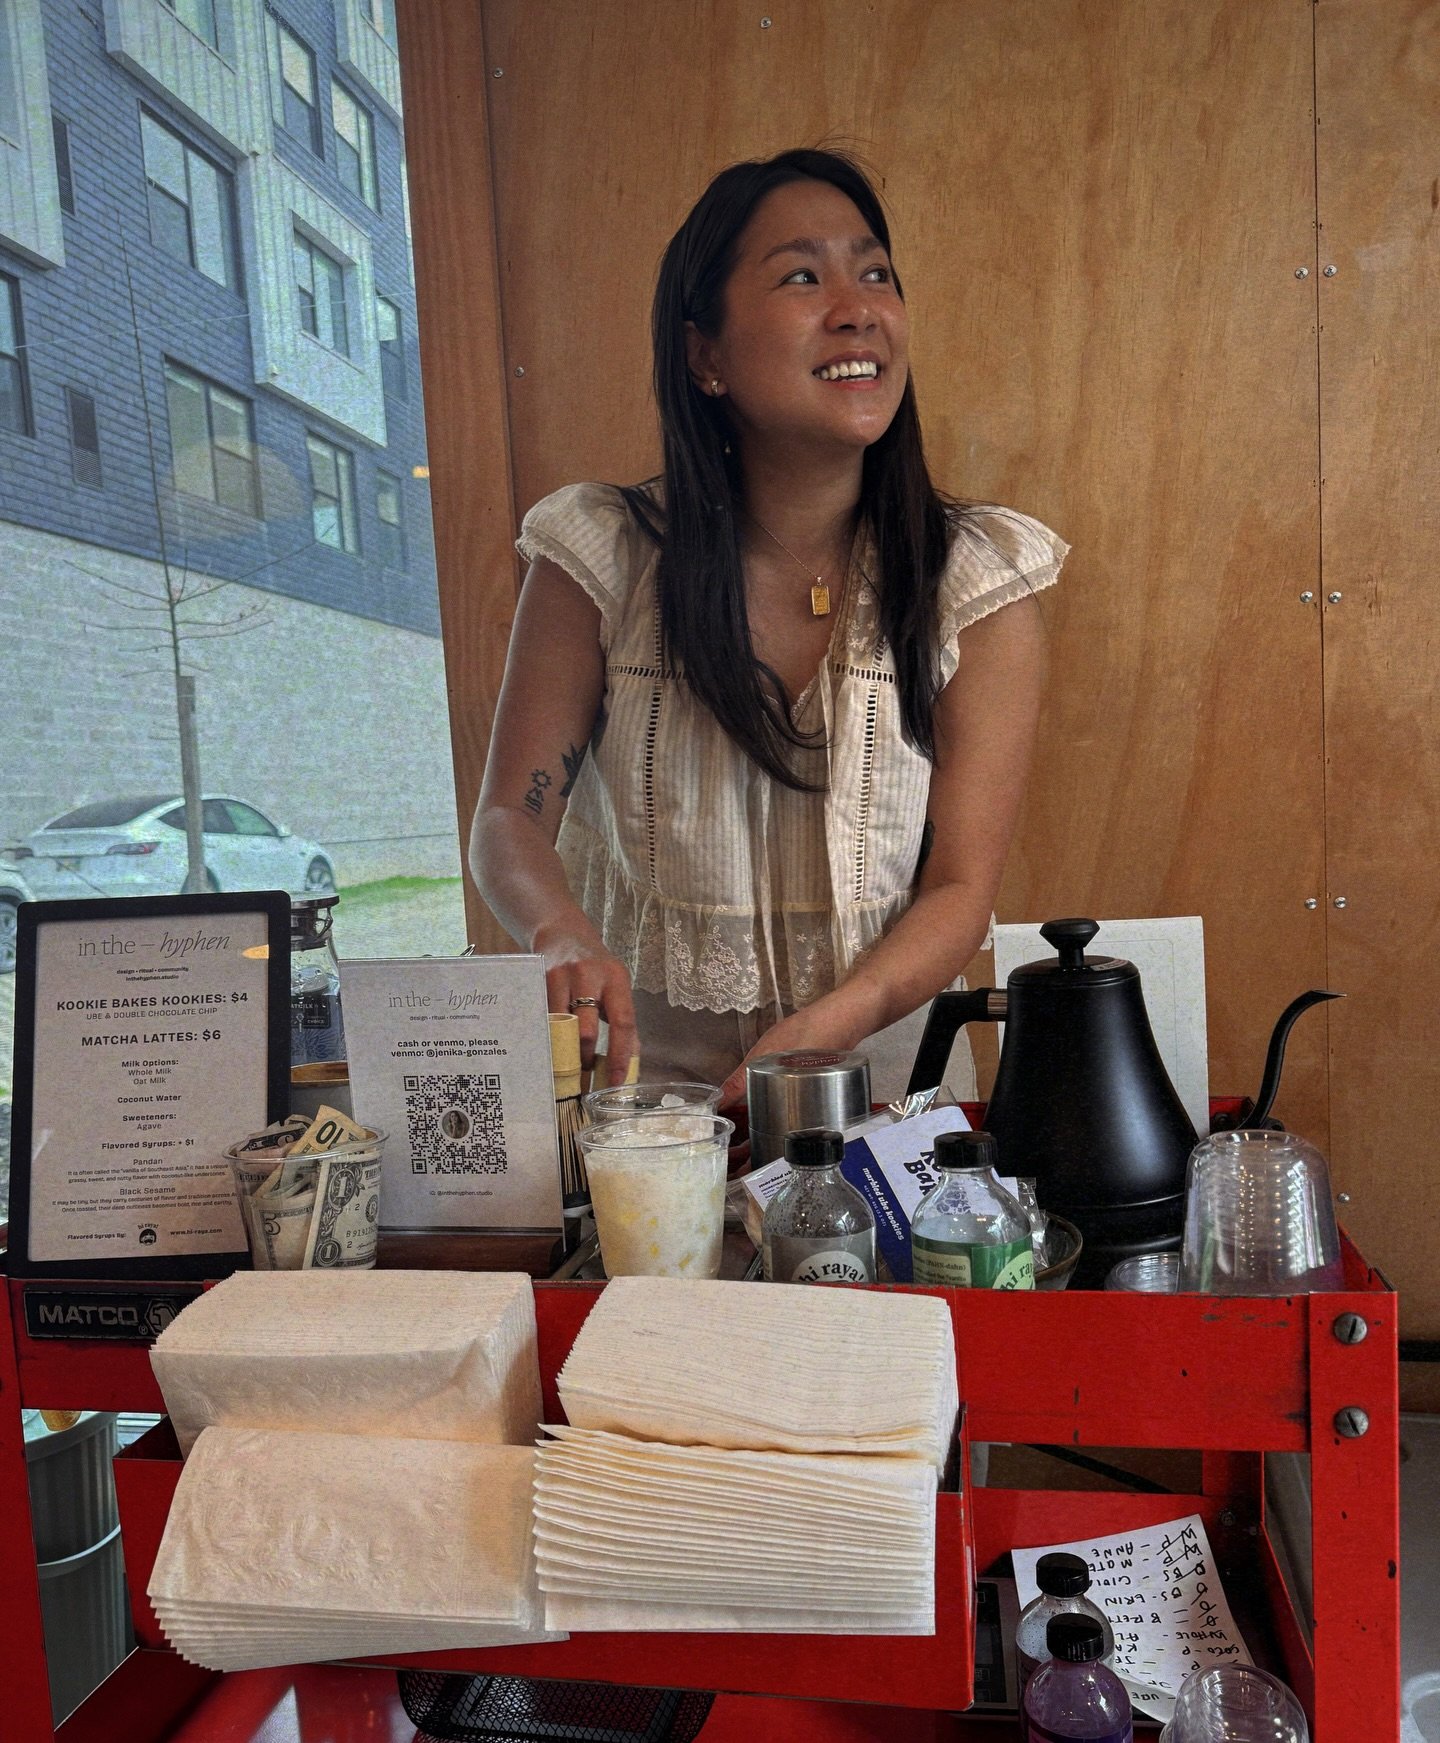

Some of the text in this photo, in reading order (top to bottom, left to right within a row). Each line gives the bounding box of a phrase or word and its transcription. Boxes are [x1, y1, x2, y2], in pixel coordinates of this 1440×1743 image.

[79, 938, 96, 956] in
[101, 934, 136, 956] the
[160, 930, 230, 959] hyphen
[57, 991, 248, 1010] KOOKIE BAKES KOOKIES: $4
[389, 993, 403, 1008] in
[405, 990, 431, 1007] the
[448, 989, 498, 1010] hyphen
[148, 1008, 196, 1017] CHOCOLATE
[81, 1029, 221, 1046] MATCHA LATTES: $6
[397, 1039, 419, 1047] cash
[433, 1040, 466, 1048] venmo,
[469, 1038, 499, 1047] please
[391, 1048, 507, 1058] venmo: @jenika-gonzales
[142, 1059, 179, 1068] Options:
[137, 1123, 162, 1131] Agave
[142, 1140, 176, 1148] Syrups:
[903, 1160, 938, 1196] Bak
[144, 1187, 176, 1195] Sesame
[862, 1168, 905, 1240] marbled ube kookies
[170, 1228, 222, 1236] www.hi-raya.com
[347, 1240, 353, 1249] 2
[799, 1265, 820, 1282] hi
[39, 1305, 139, 1326] MATCO
[1091, 1541, 1134, 1559] ANNE
[1105, 1593, 1146, 1607] ERIN
